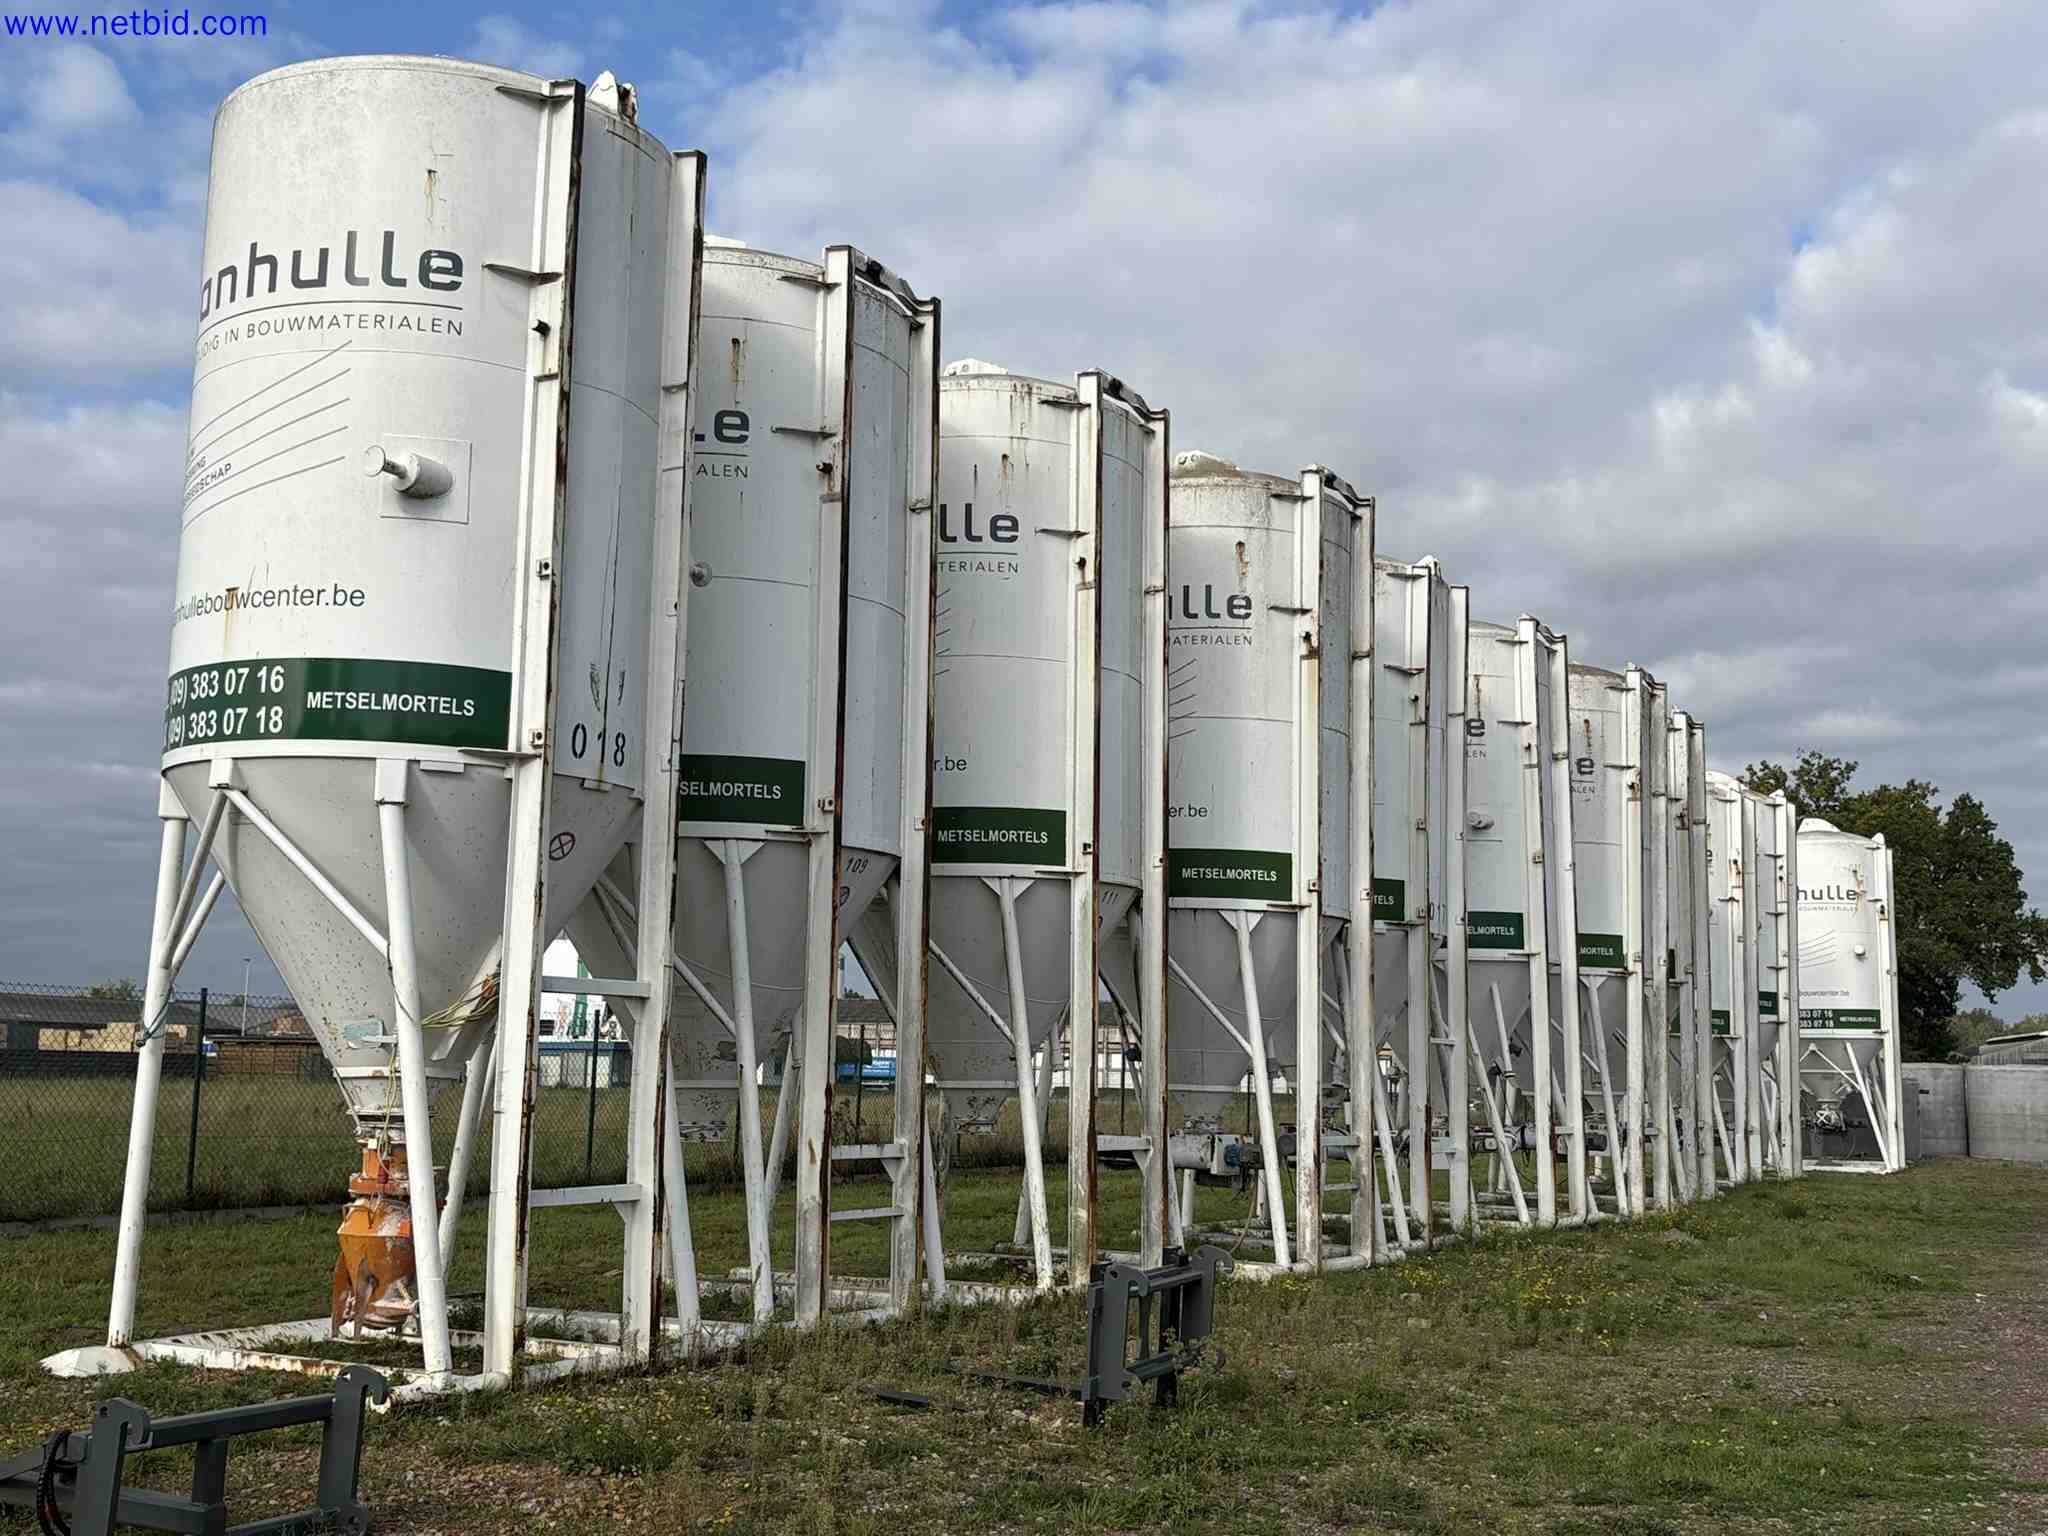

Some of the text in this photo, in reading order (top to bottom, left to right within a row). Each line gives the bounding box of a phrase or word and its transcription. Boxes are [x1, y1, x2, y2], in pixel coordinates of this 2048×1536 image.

[224, 327, 239, 344] IN
[247, 313, 463, 338] BOUWMATERIALEN
[696, 463, 748, 478] ALEN
[939, 502, 1019, 543] lle
[938, 560, 1018, 574] TERIALEN
[190, 670, 220, 701] 383
[224, 667, 250, 696] 07
[256, 665, 285, 694] 16
[307, 691, 475, 717] METSELMORTELS
[188, 709, 218, 740] 383
[223, 706, 249, 736] 07
[256, 705, 284, 734] 18
[679, 781, 783, 800] SELMORTELS
[938, 829, 1049, 845] METSELMORTELS
[1182, 866, 1278, 882] METSELMORTELS
